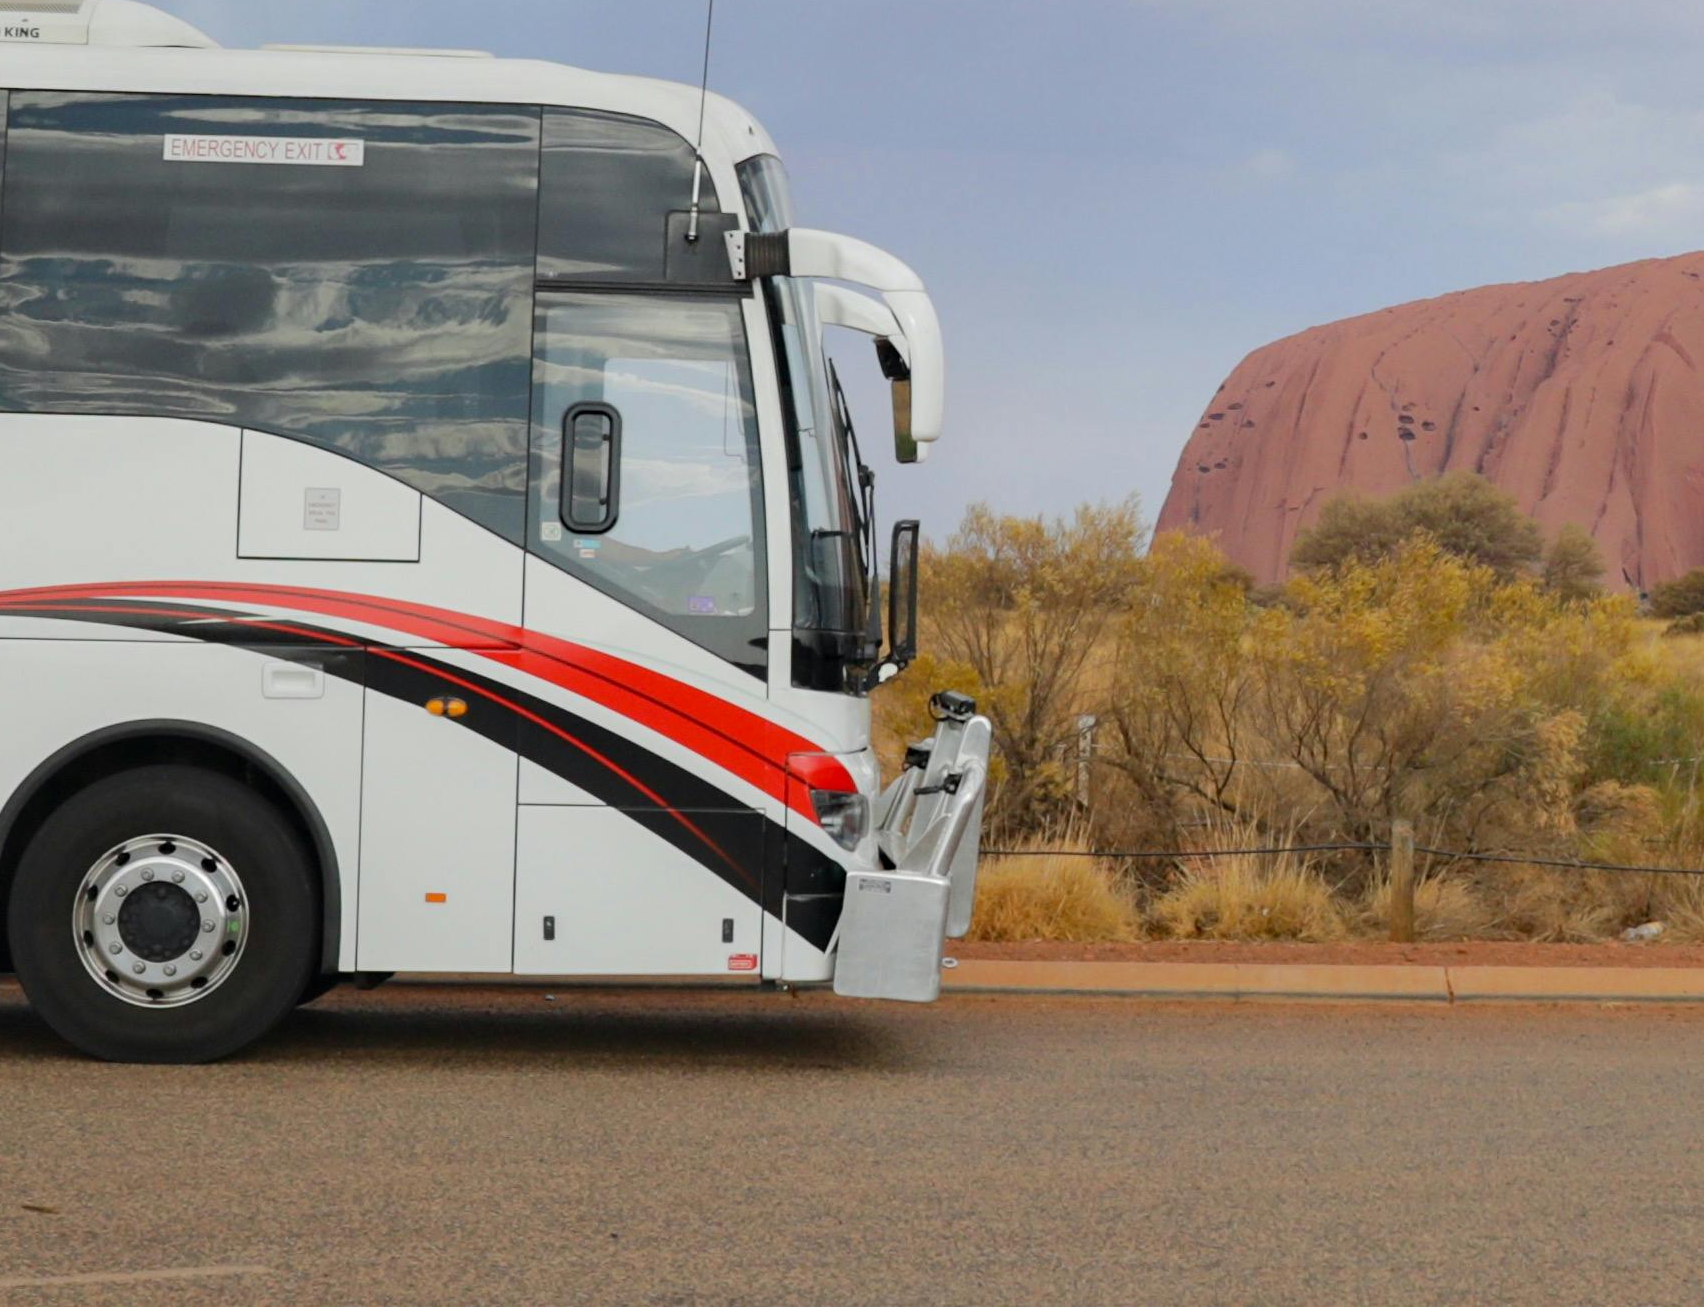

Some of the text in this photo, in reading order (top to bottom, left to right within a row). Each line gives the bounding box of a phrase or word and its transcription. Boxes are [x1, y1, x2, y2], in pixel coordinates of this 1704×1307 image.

[4, 26, 40, 38] KING
[170, 138, 322, 160] EMERGENCY EXIT
